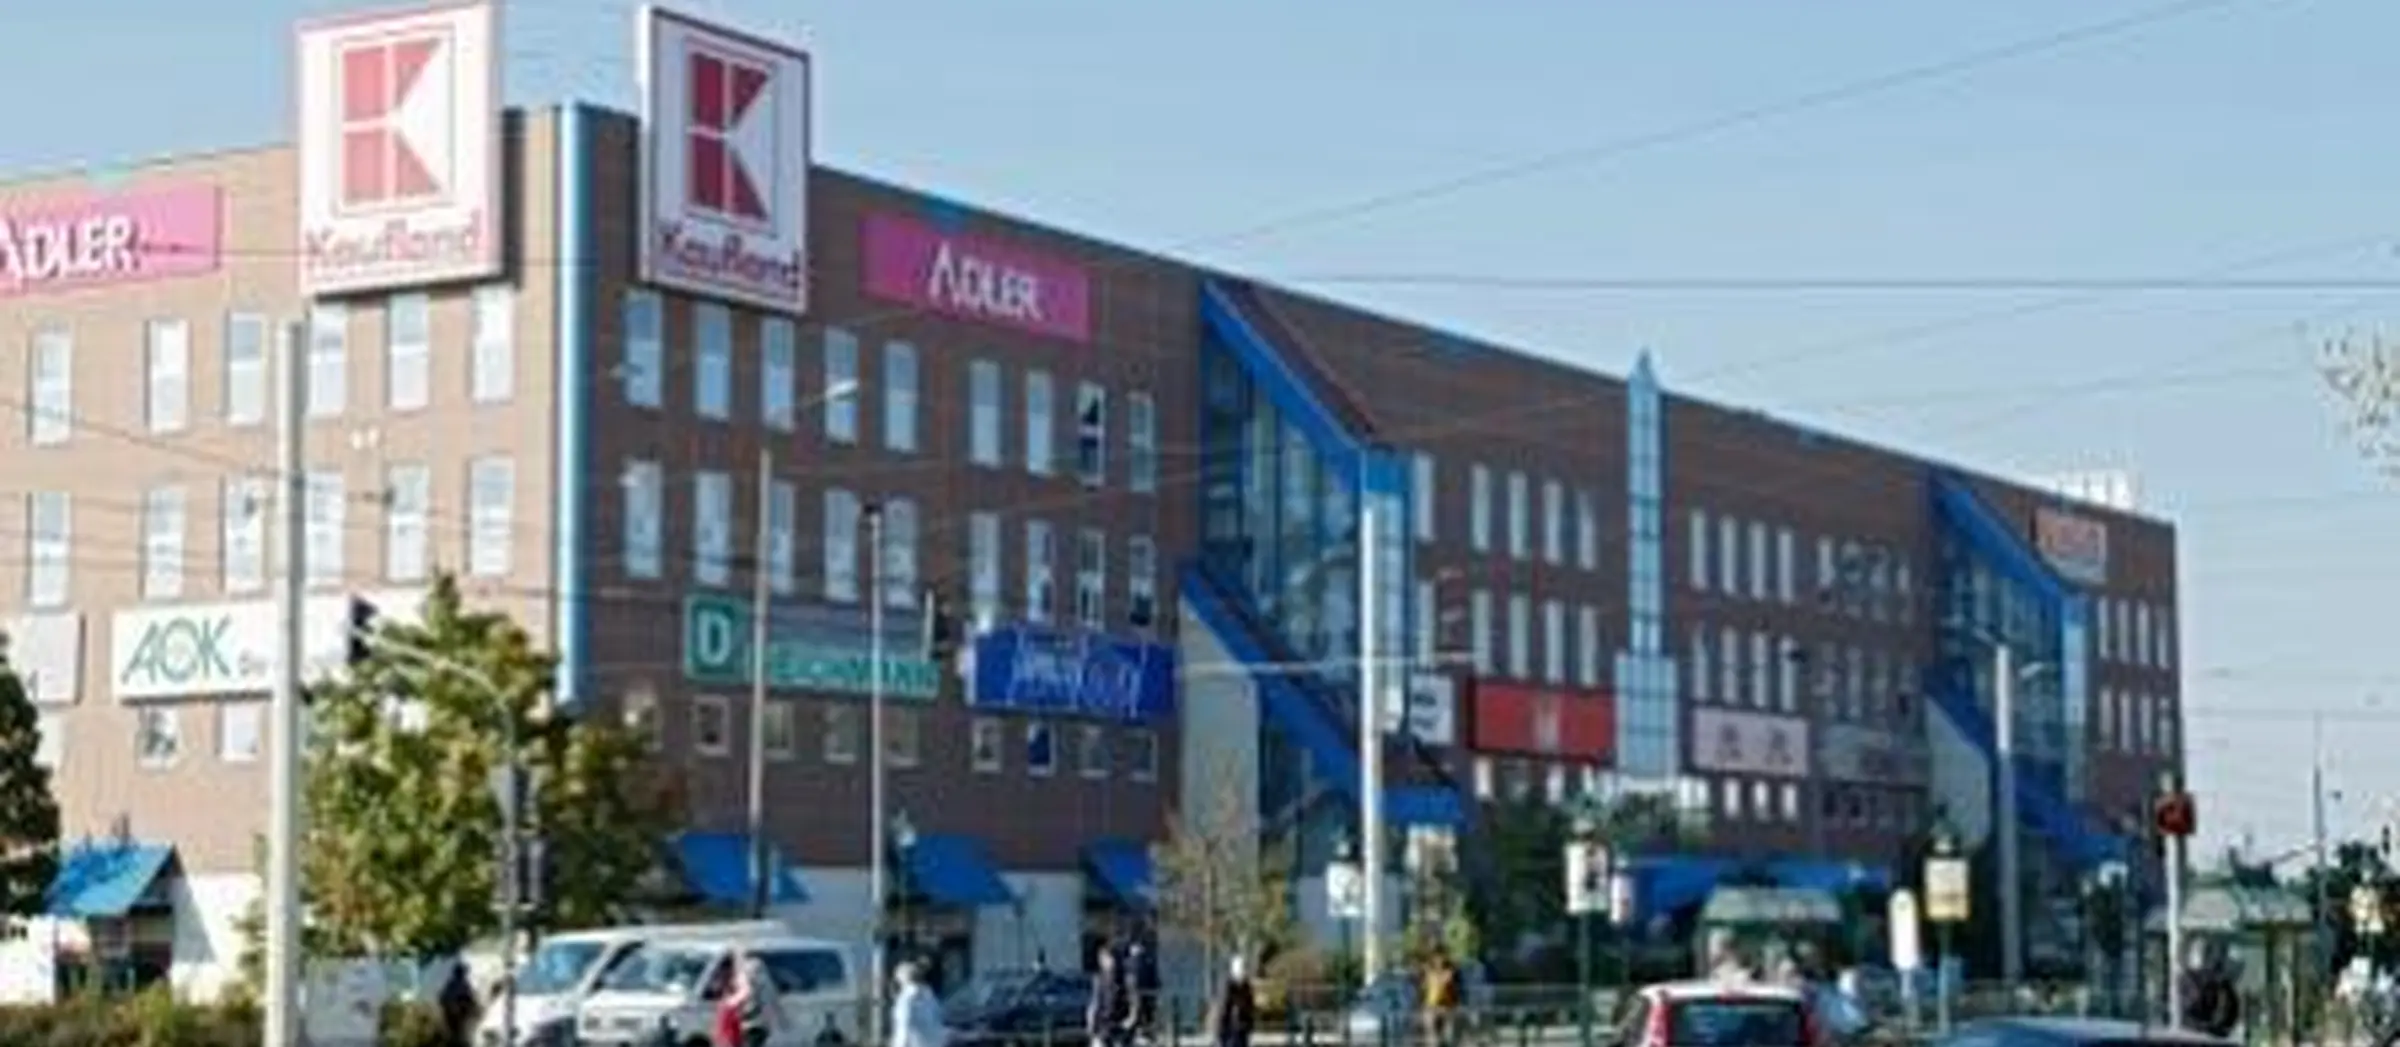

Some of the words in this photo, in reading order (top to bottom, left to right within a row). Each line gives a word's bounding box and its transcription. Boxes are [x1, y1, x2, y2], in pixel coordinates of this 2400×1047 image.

[927, 239, 1045, 322] ADLER
[121, 614, 233, 686] AOK
[697, 609, 732, 667] D
